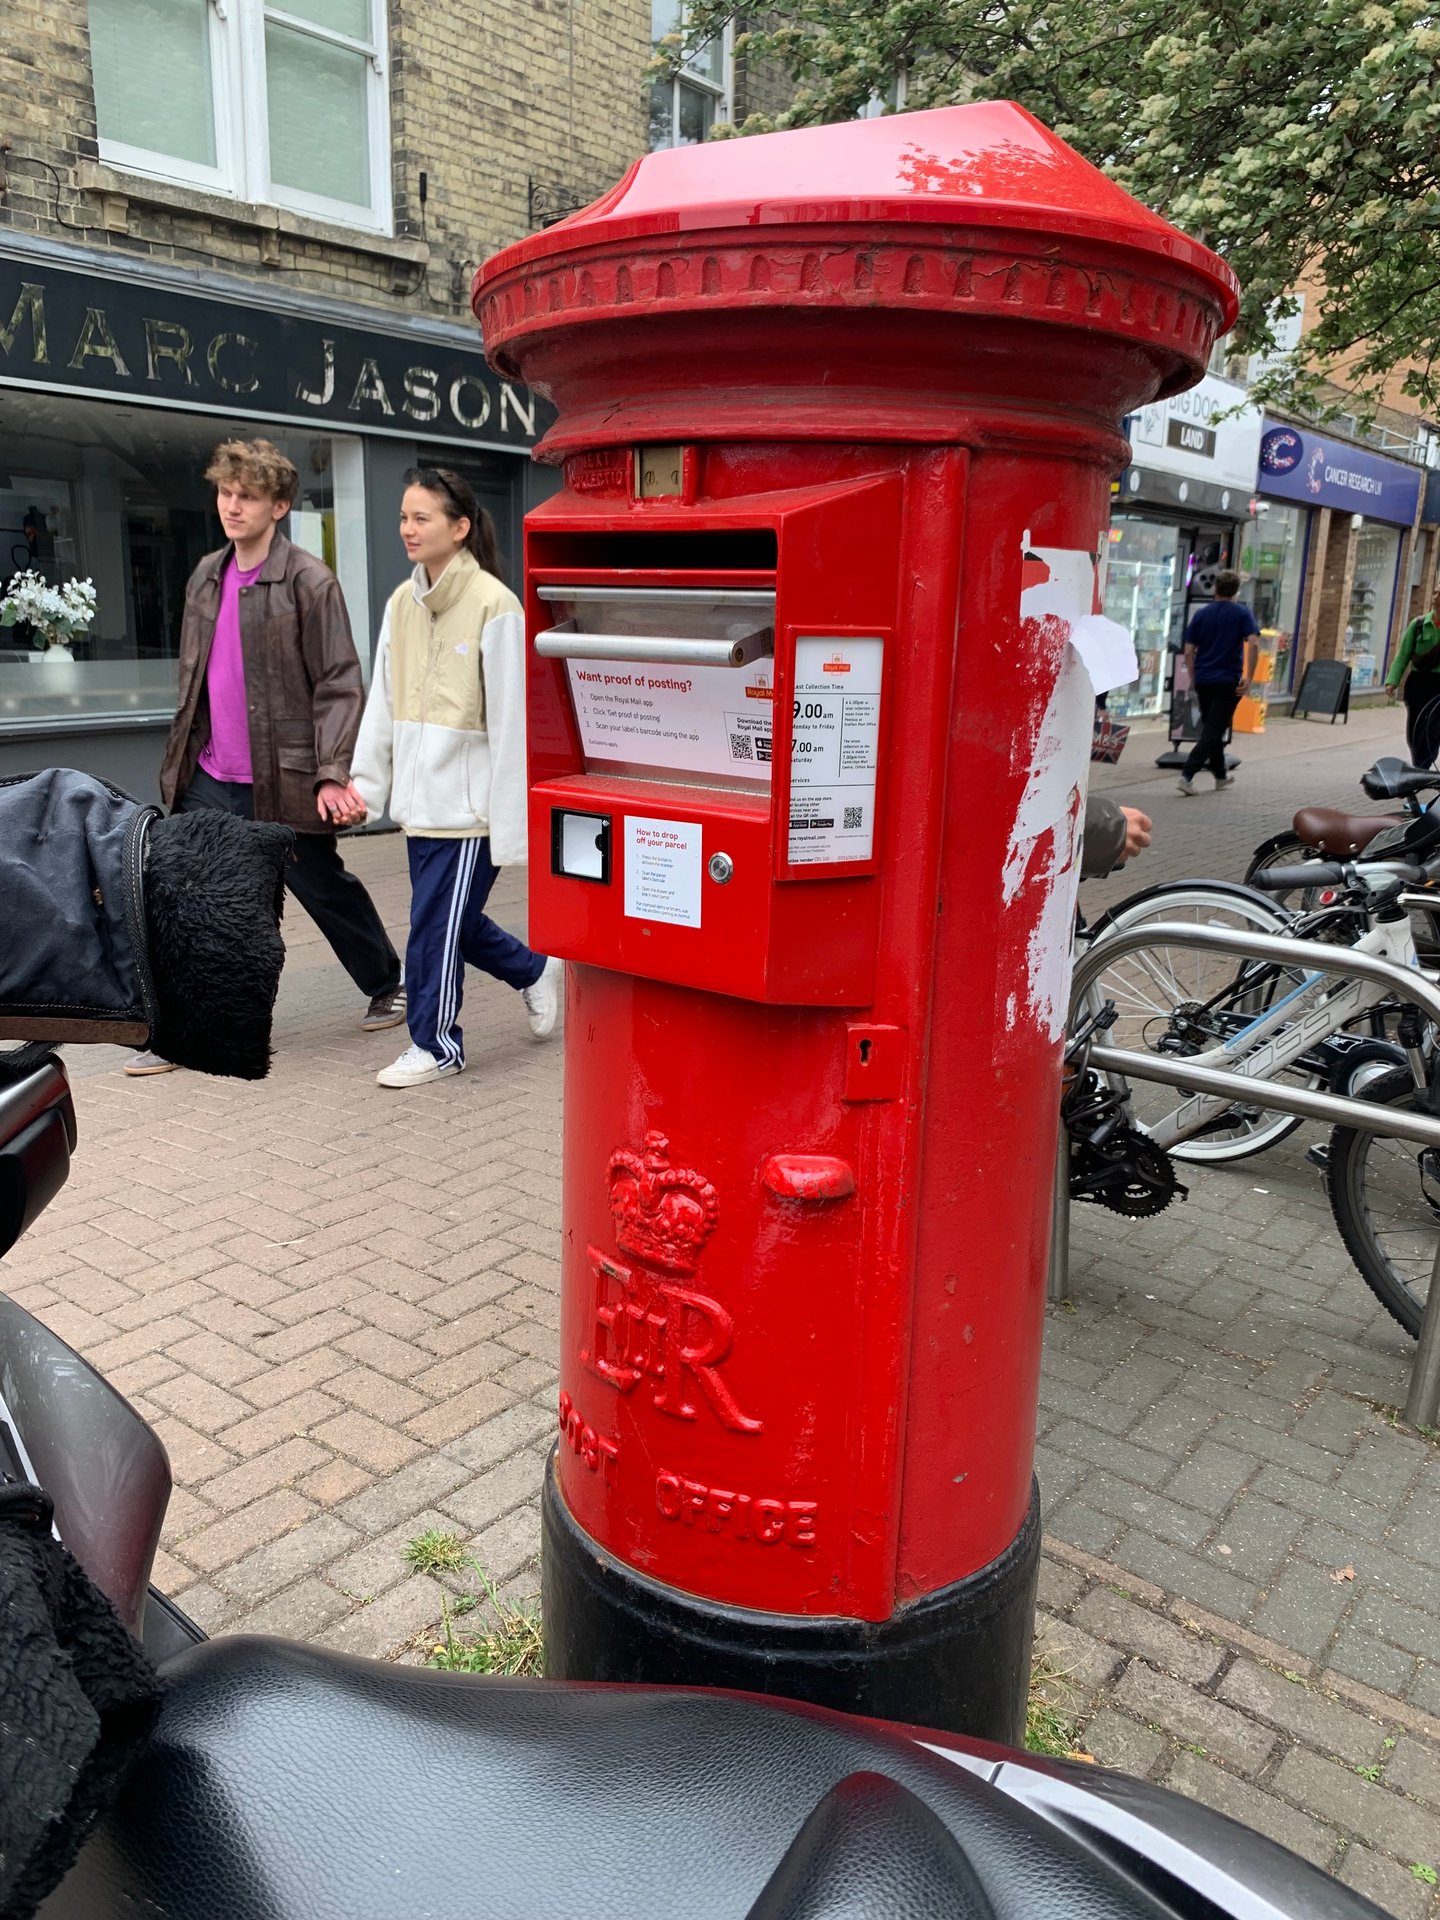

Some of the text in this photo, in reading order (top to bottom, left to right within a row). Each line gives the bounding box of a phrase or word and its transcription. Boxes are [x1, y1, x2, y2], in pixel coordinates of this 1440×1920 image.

[0, 281, 536, 436] MARC JASON
[1169, 391, 1190, 414] BIG
[1180, 426, 1203, 450] LAND
[1324, 466, 1348, 488] CANCER
[1348, 472, 1375, 495] RESEARCH
[824, 664, 838, 672] Royal
[576, 670, 692, 693] Want proof of posting?
[590, 693, 604, 702] Open
[614, 696, 629, 705] Royal
[629, 698, 642, 706] Mail
[643, 700, 654, 708] app
[747, 688, 765, 698] Royal
[593, 707, 606, 717] Click
[618, 711, 632, 720] proof
[793, 701, 823, 719] 9.00
[737, 718, 762, 726] Download
[737, 724, 751, 732] Royal
[595, 722, 609, 730] Scan
[609, 724, 622, 733] your
[640, 727, 662, 738] barcode
[663, 730, 678, 741] using
[679, 732, 688, 740] the
[689, 733, 700, 742] app
[791, 740, 824, 754] 7.00 am
[636, 828, 652, 837] How
[662, 832, 679, 840] drop
[636, 837, 687, 850] off your parcel
[656, 1470, 818, 1546] OFFICE
